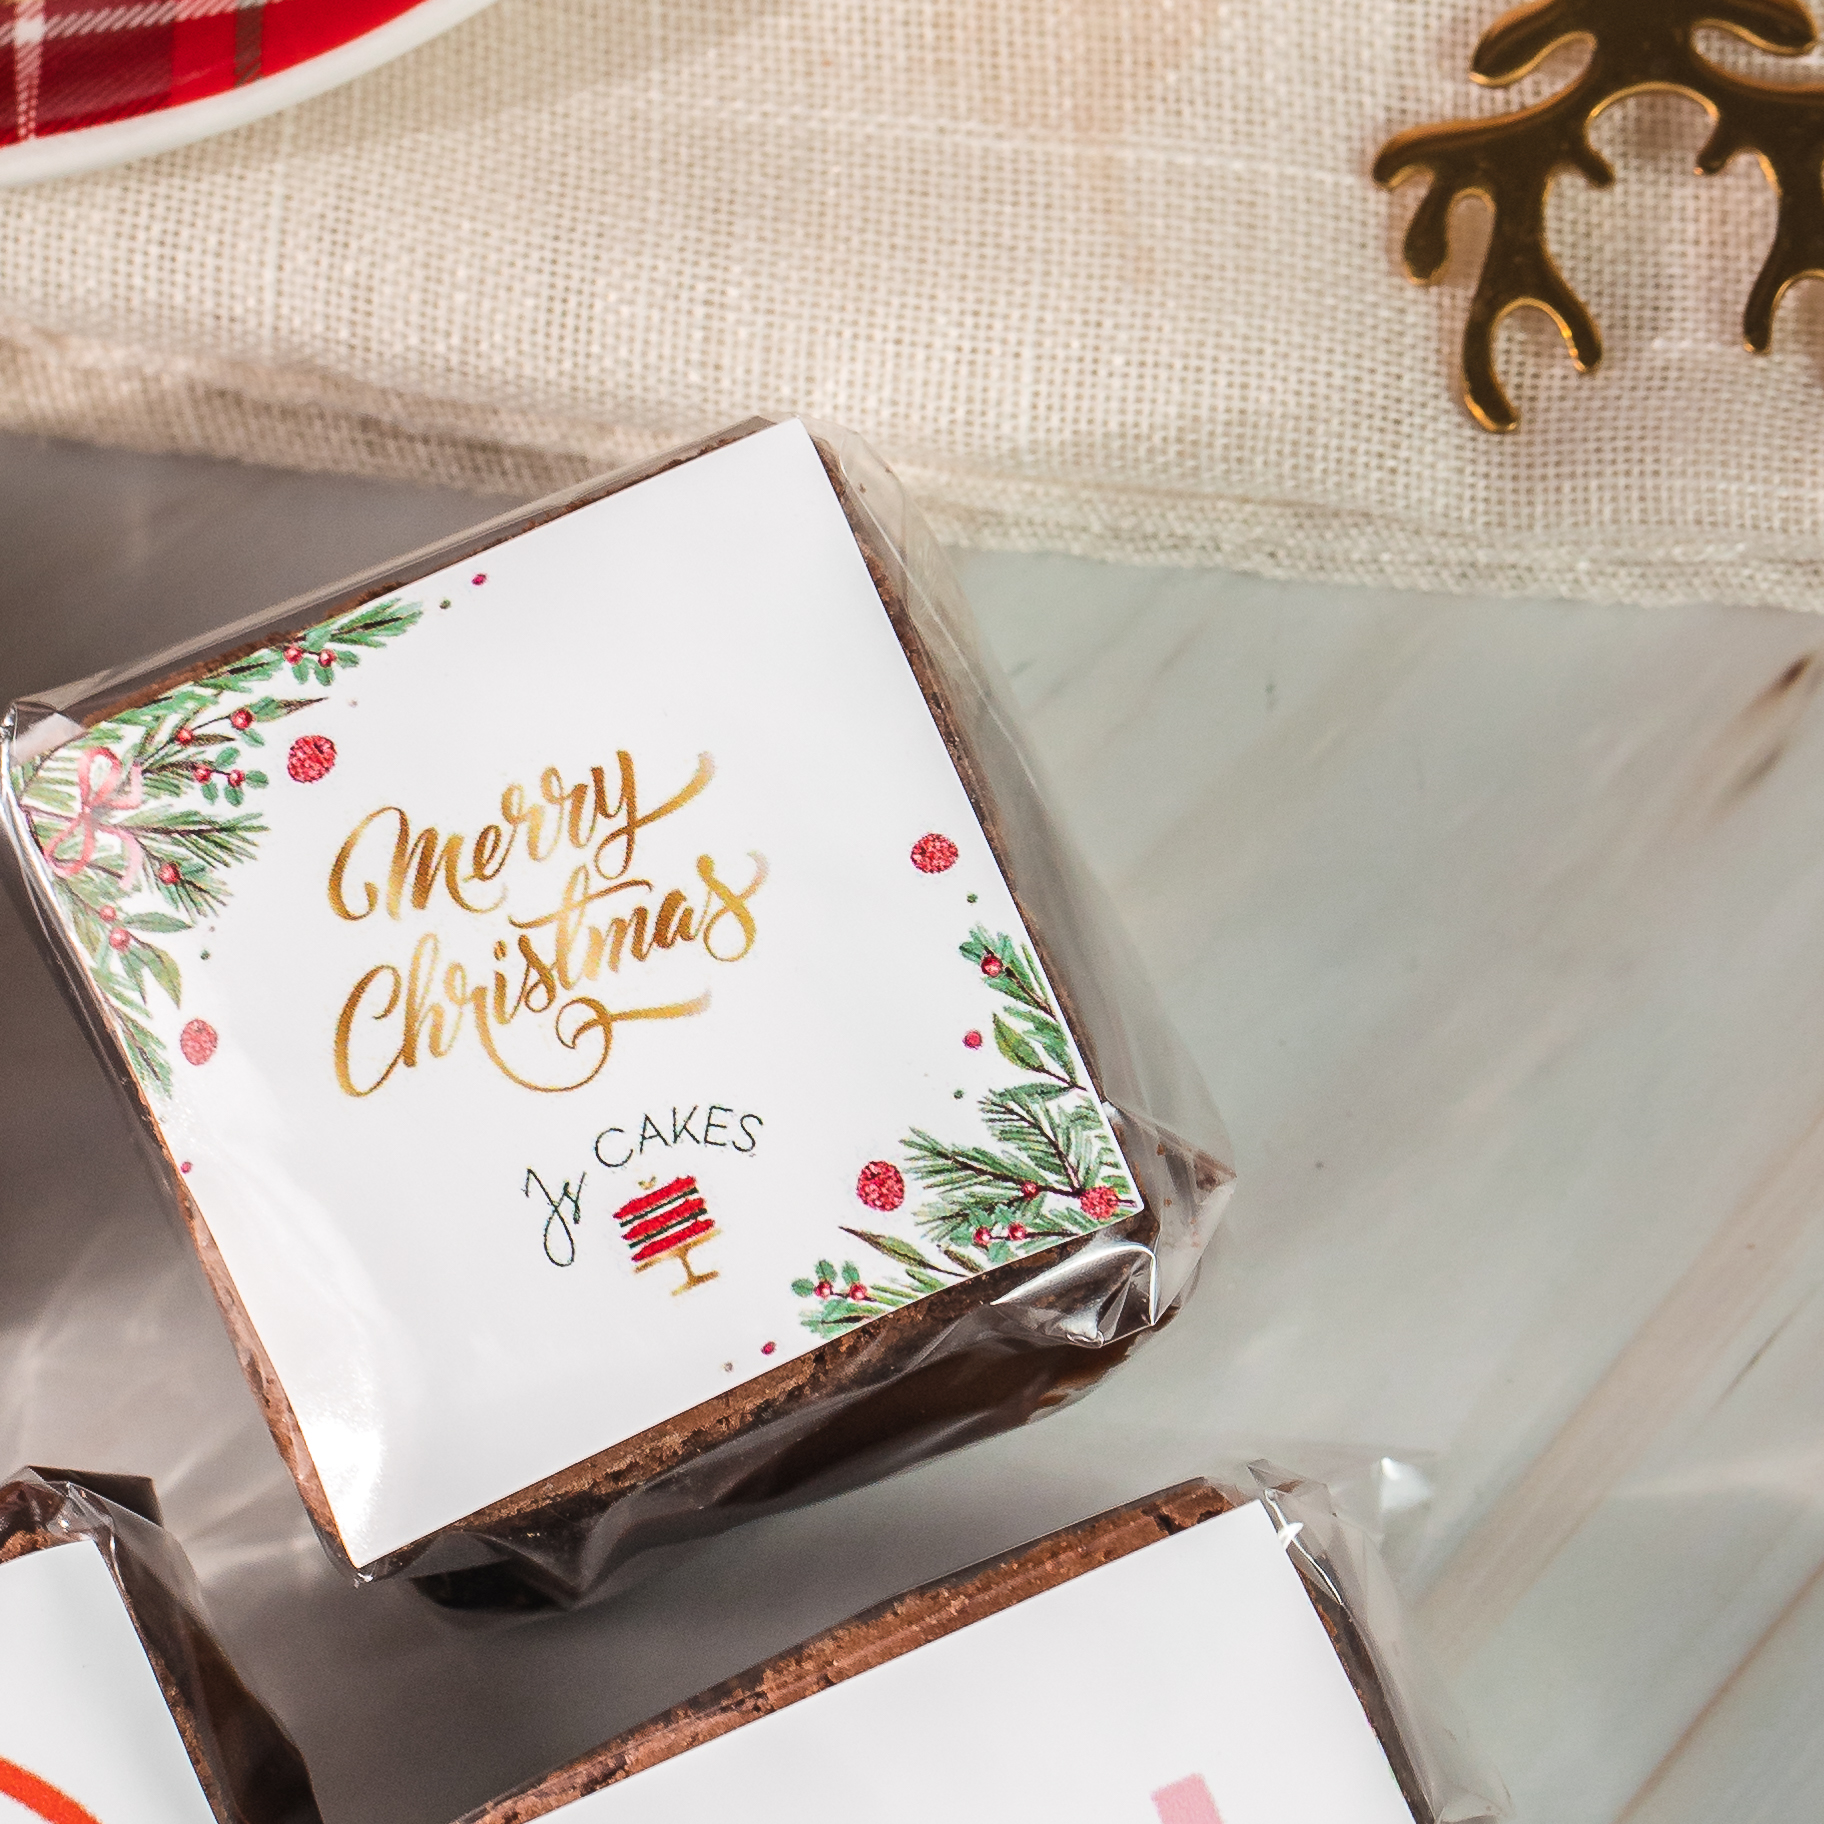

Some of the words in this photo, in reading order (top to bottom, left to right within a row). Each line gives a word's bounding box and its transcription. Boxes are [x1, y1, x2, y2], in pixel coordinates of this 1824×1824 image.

[328, 750, 716, 922] Merry
[333, 852, 770, 1096] Christmas
[594, 1105, 764, 1168] CAKES
